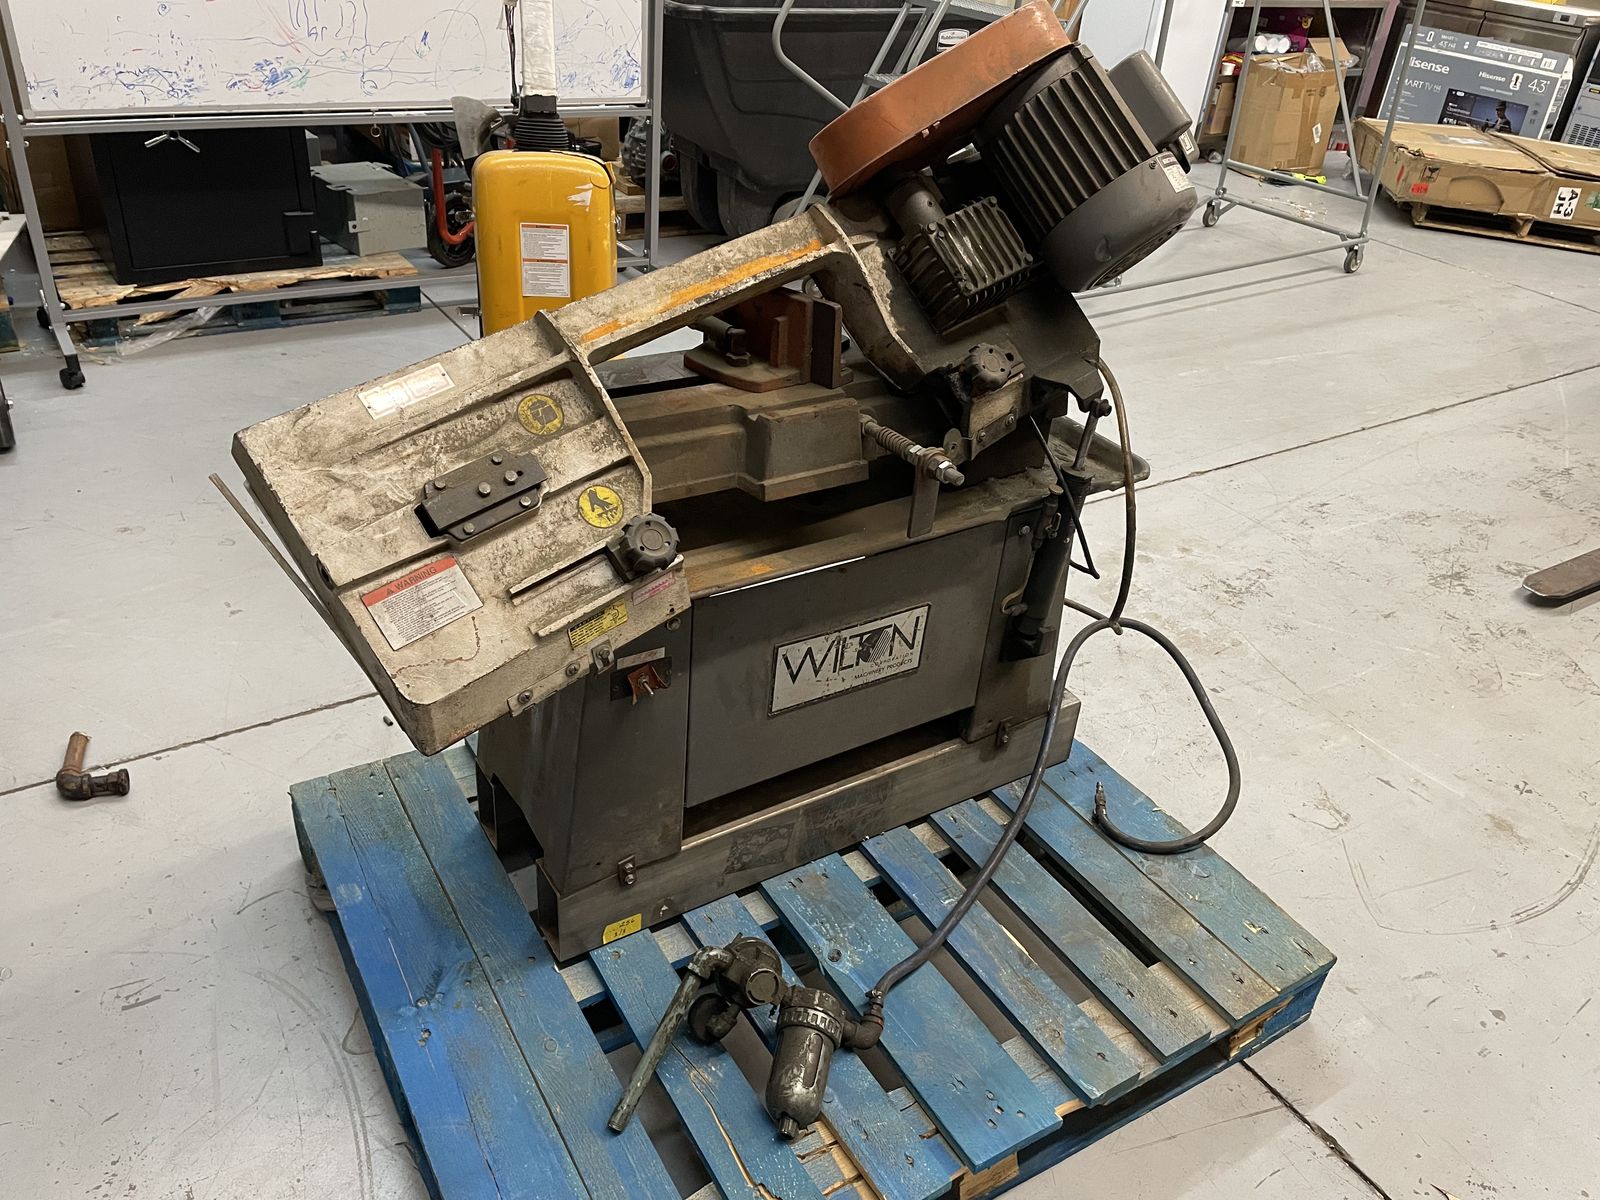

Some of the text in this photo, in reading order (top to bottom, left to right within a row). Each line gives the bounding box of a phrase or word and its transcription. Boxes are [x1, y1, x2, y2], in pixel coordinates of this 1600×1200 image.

[1478, 71, 1506, 83] Hisense
[395, 566, 437, 591] WARNING
[781, 615, 920, 685] WILTON
[887, 658, 913, 671] PRODUCTS
